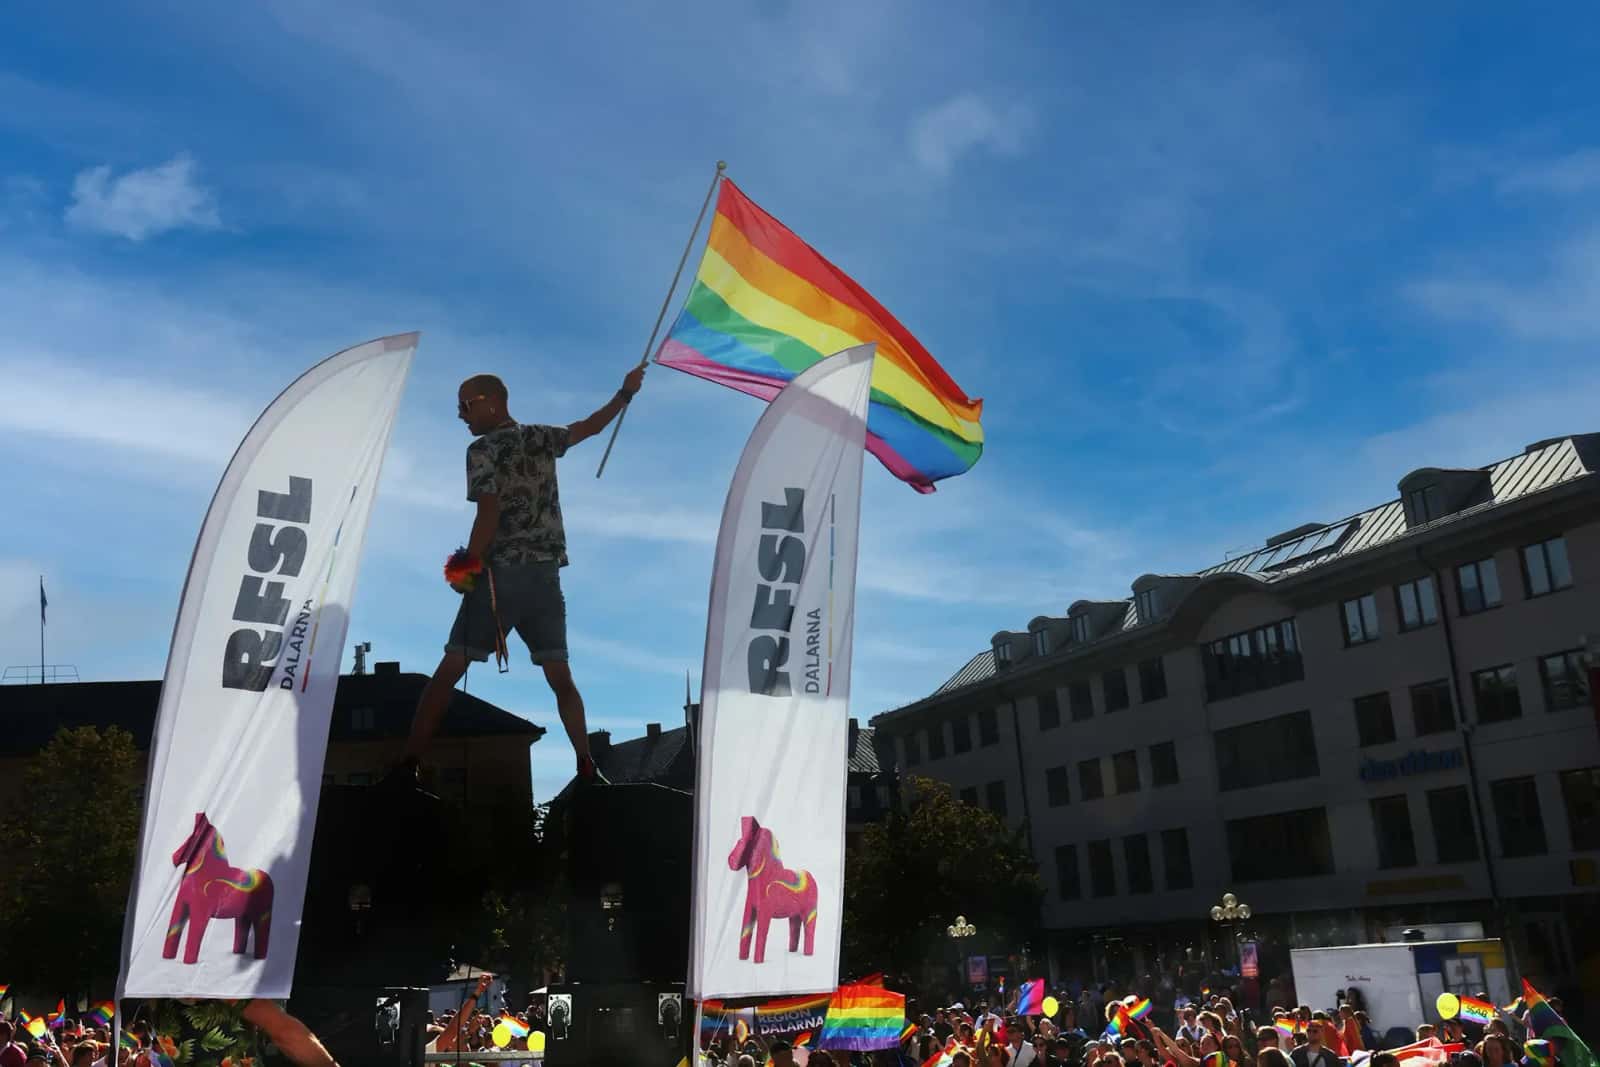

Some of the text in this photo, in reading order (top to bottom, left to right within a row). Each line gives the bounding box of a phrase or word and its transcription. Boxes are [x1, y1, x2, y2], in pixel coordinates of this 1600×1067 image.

[222, 475, 313, 692] RFSL
[747, 487, 806, 697] RFSL
[280, 599, 313, 690] DALARNA
[805, 607, 822, 694] DALARNA
[758, 1008, 811, 1024] REGION
[760, 1016, 823, 1034] DALARNA
